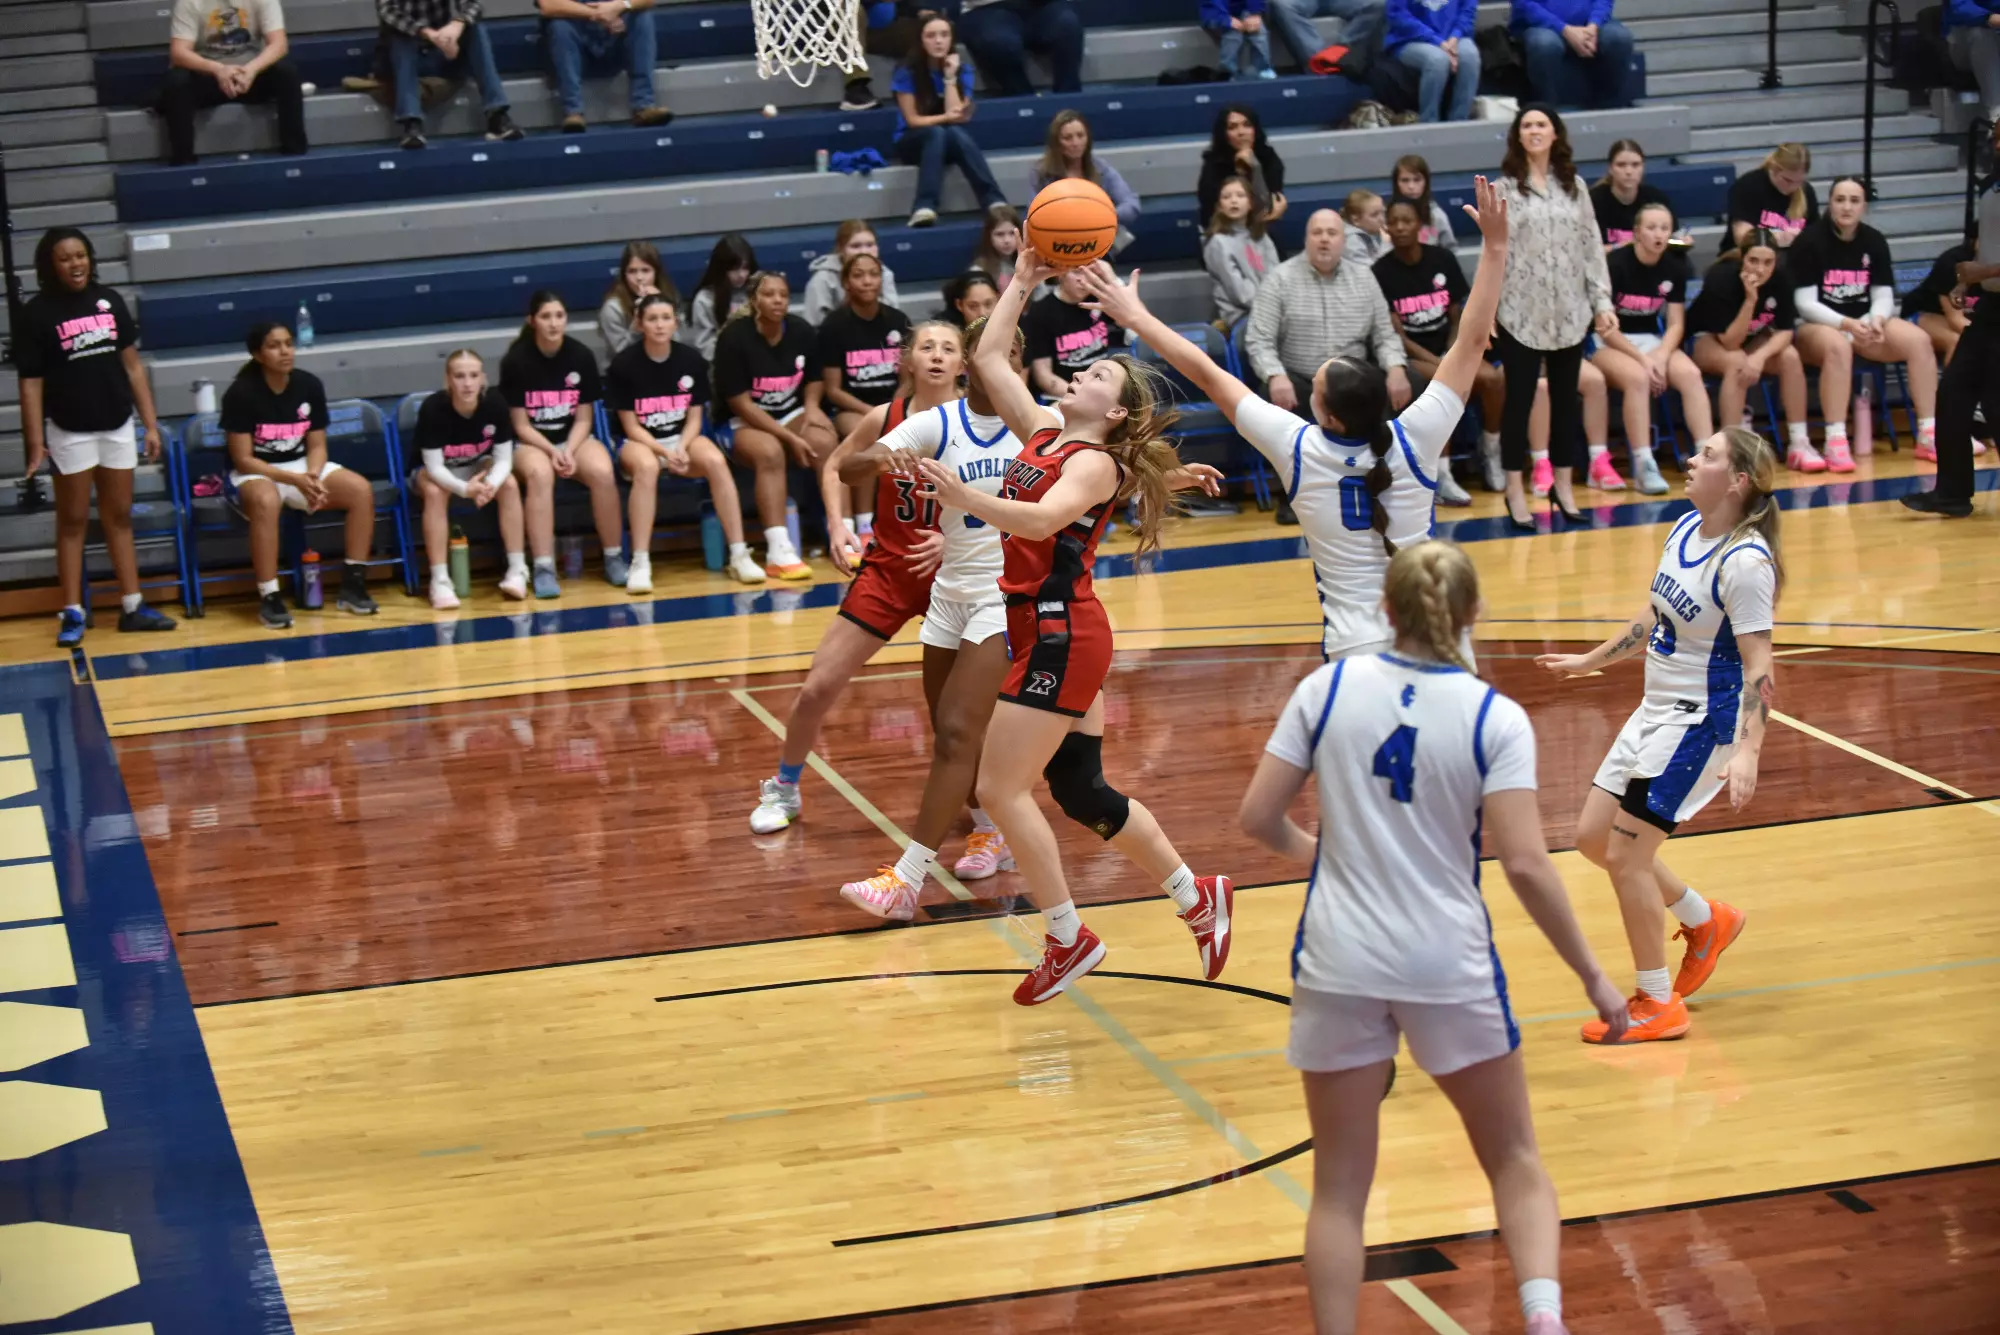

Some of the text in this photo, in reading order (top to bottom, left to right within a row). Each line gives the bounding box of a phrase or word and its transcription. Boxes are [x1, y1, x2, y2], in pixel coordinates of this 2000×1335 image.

[1052, 239, 1098, 255] NCAA
[958, 457, 1011, 484] ADYBL
[1004, 458, 1047, 490] IPON
[892, 477, 938, 528] 31
[1338, 475, 1372, 531] 0
[1650, 570, 1702, 624] DYBLUES
[1370, 724, 1419, 803] 4
